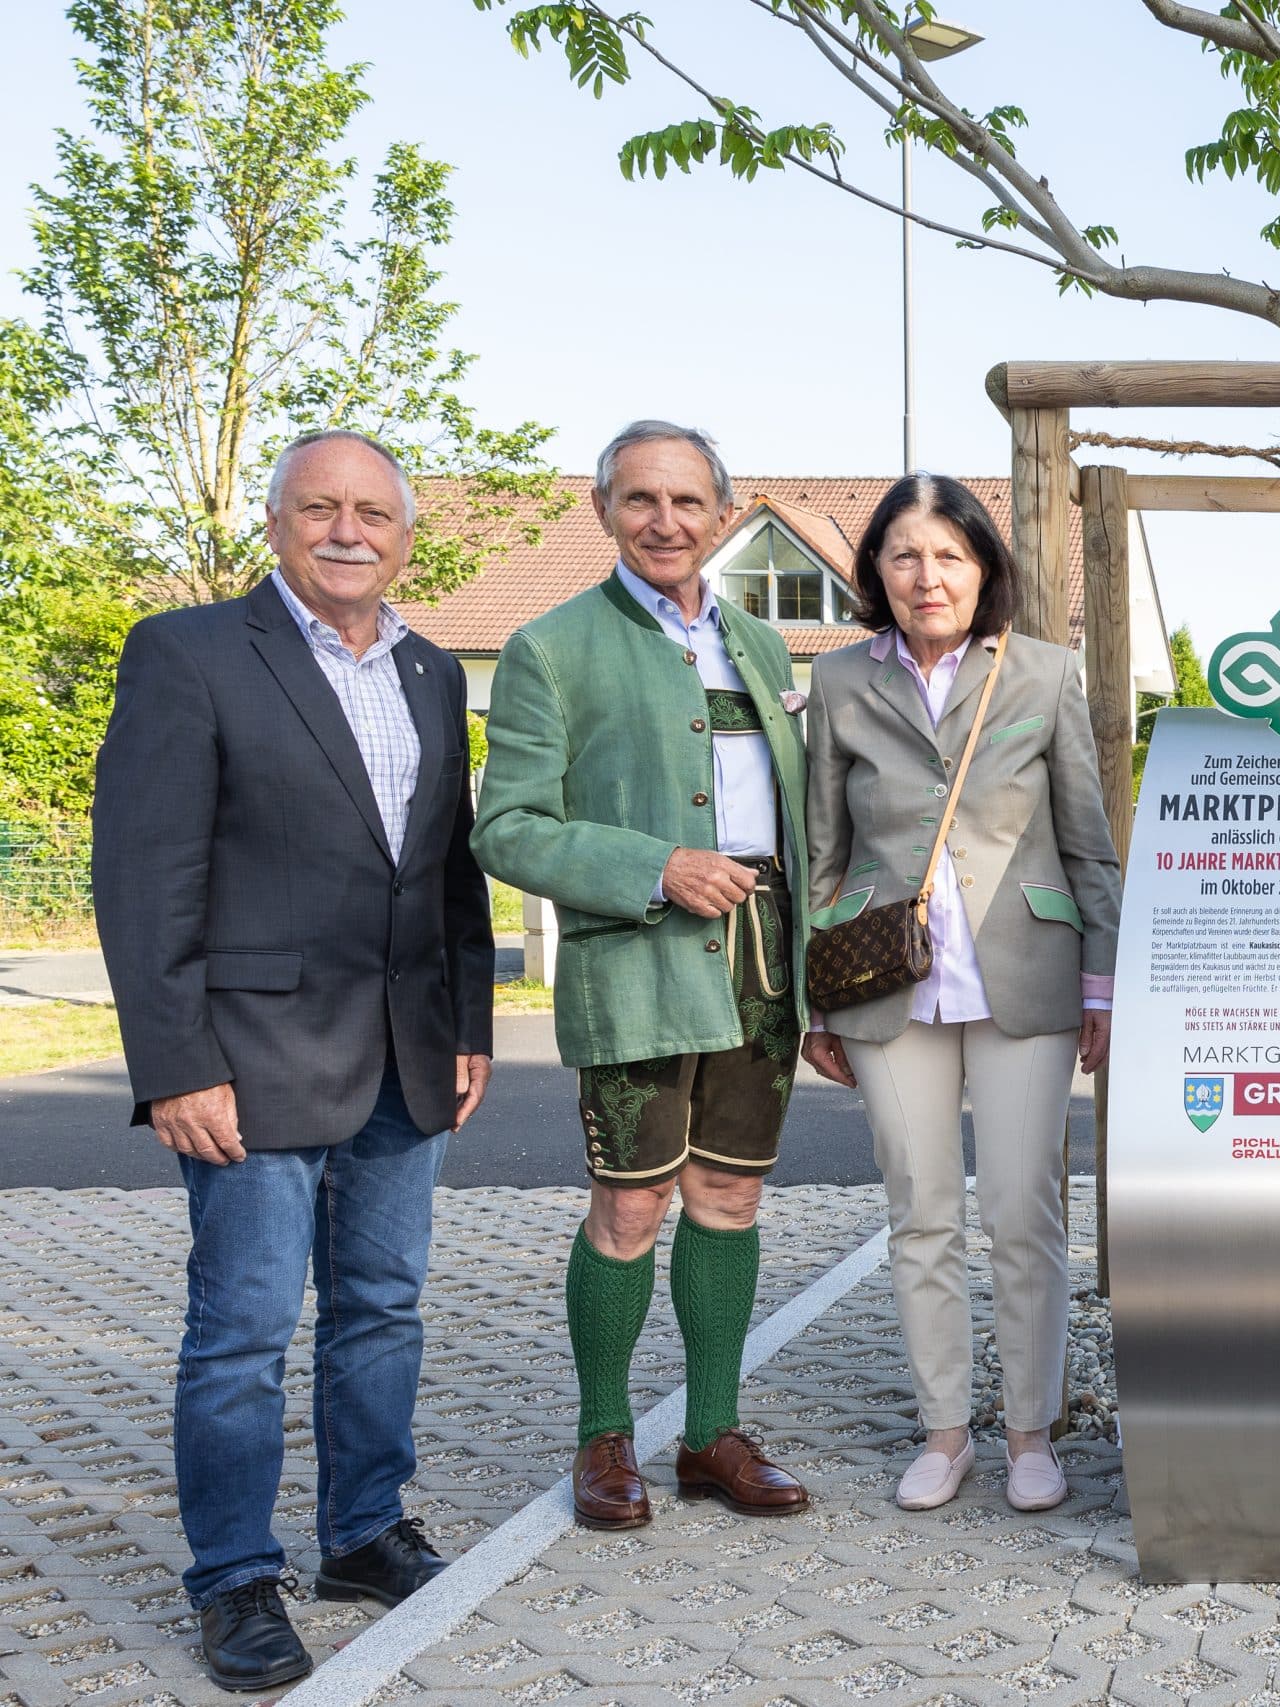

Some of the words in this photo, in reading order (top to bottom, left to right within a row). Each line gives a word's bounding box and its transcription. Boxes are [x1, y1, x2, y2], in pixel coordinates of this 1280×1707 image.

[1204, 754, 1232, 769] Zum
[1191, 771, 1215, 786] und
[1212, 829, 1275, 846] anlässlich
[1157, 851, 1173, 870] 10
[1178, 851, 1226, 870] JAHRE
[1201, 878, 1217, 896] im
[1222, 878, 1274, 896] Oktober
[1153, 906, 1159, 915] Er
[1161, 906, 1171, 915] soll
[1173, 906, 1188, 915] auch
[1189, 906, 1197, 915] als
[1200, 906, 1228, 915] bleibende
[1231, 906, 1263, 916] Erinnerung
[1265, 907, 1272, 915] an
[1153, 917, 1184, 926] Gemeinde
[1186, 918, 1193, 926] zu
[1194, 917, 1216, 927] Beginn
[1217, 917, 1228, 926] des
[1195, 927, 1207, 936] und
[1208, 927, 1232, 936] Vereinen
[1234, 927, 1251, 936] wurde
[1253, 927, 1270, 936] dieser
[1152, 941, 1162, 950] Der
[1232, 941, 1245, 950] eine
[1151, 951, 1188, 961] imposanter,
[1190, 951, 1222, 960] klimafitter
[1223, 951, 1256, 960] Laubbaum
[1258, 952, 1269, 960] aus
[1270, 951, 1280, 960] der
[1190, 962, 1201, 971] des
[1203, 962, 1230, 971] Kaukasus
[1232, 962, 1244, 971] und
[1268, 963, 1275, 971] zu
[1151, 973, 1184, 982] Besonders
[1187, 973, 1211, 982] zierend
[1214, 973, 1231, 982] wirkt
[1234, 974, 1242, 982] er
[1243, 973, 1251, 982] im
[1254, 973, 1275, 982] Herbst
[1150, 984, 1160, 993] die
[1271, 984, 1277, 993] Er
[1186, 1007, 1206, 1017] MÖGE
[1210, 1007, 1219, 1017] ER
[1223, 1007, 1259, 1017] WACHSEN
[1263, 1007, 1277, 1017] WIE
[1185, 1020, 1200, 1031] UNS
[1202, 1020, 1223, 1031] STETS
[1226, 1020, 1236, 1031] AN
[1240, 1020, 1267, 1031] STÄRKE
